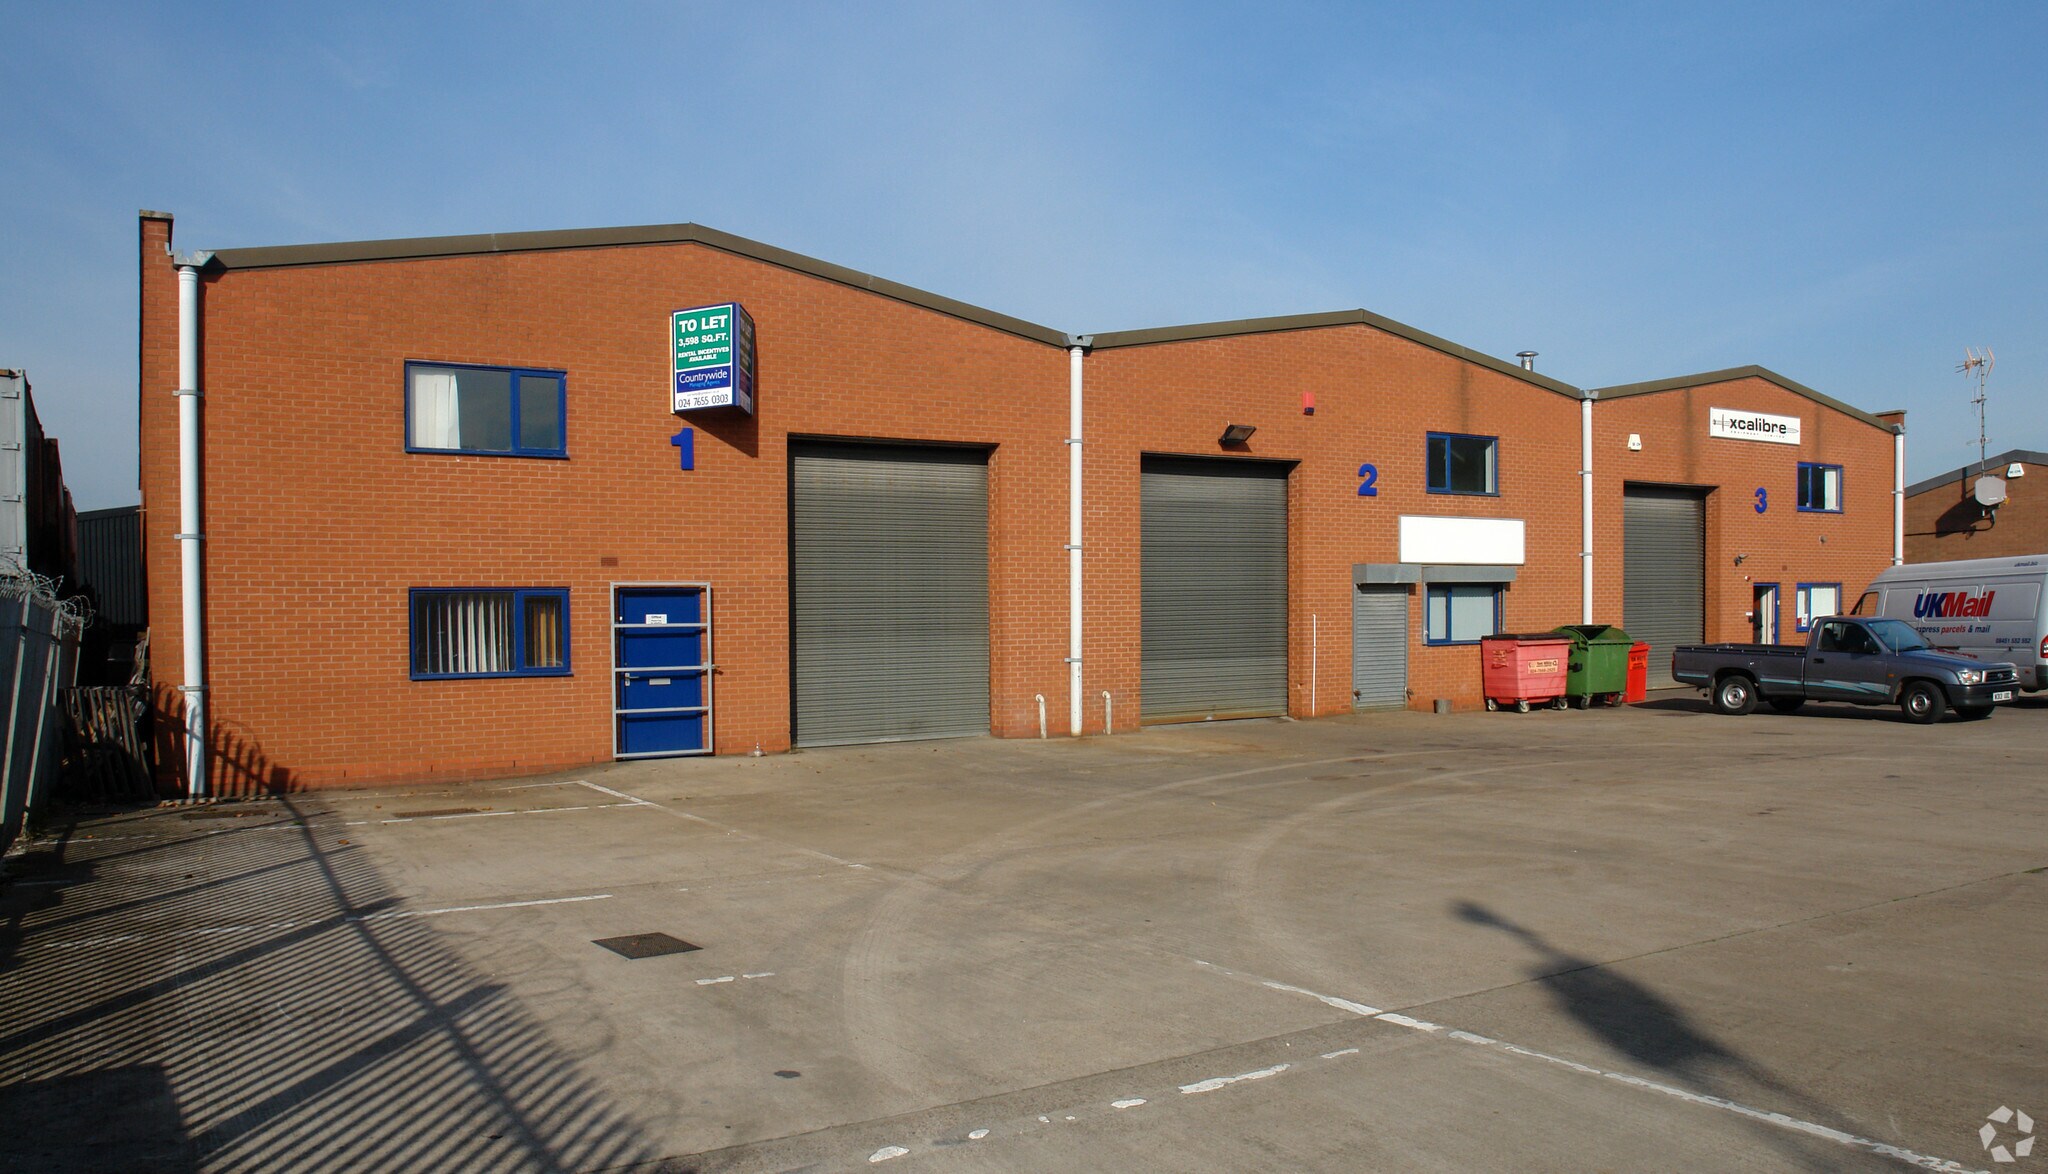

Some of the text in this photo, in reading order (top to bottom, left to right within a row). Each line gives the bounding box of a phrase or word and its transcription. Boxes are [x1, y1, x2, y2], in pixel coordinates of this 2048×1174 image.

[679, 314, 728, 333] TO LET
[678, 332, 729, 348] 3,598 SQ.FT.
[677, 346, 730, 358] RENTAL INCENTIVES
[689, 353, 717, 362] AVAILABLE
[679, 369, 728, 384] Countrywide
[678, 394, 729, 408] 024 7655 0303
[1729, 417, 1787, 434] xcalibre
[670, 427, 695, 470] 1
[1358, 463, 1378, 496] 2
[1754, 487, 1768, 514] 3
[1913, 590, 1996, 619] UKMail
[1941, 625, 1966, 635] parcels
[1968, 625, 1973, 633] &
[1974, 624, 1991, 633] mail
